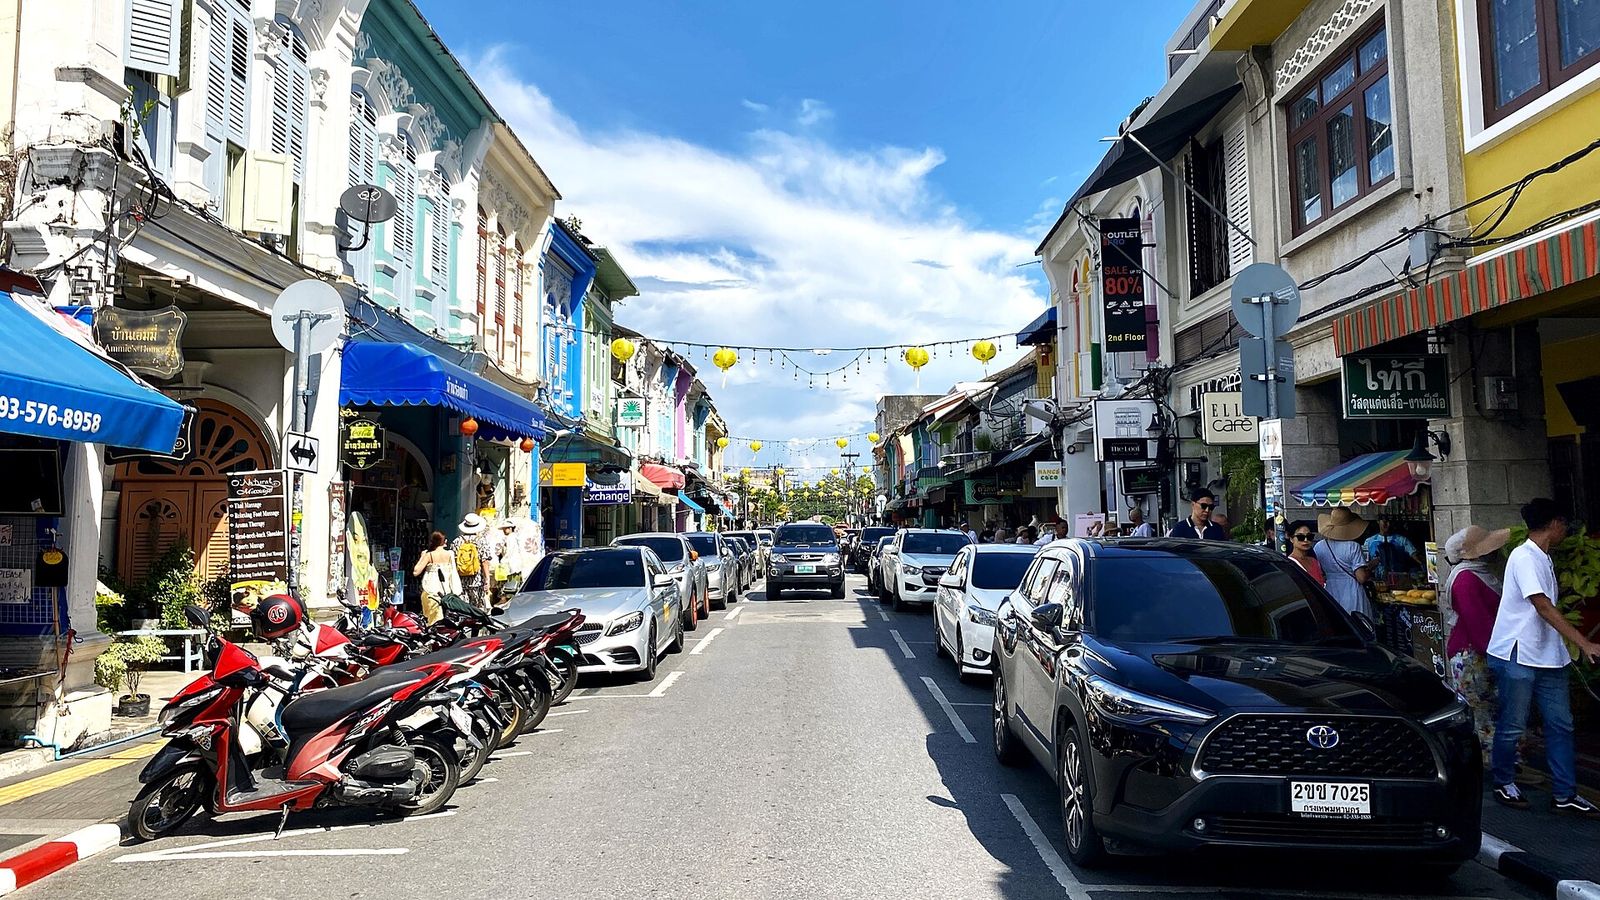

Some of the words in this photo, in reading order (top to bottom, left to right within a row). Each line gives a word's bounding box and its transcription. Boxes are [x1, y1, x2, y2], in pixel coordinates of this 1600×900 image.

[1107, 231, 1139, 239] OUTLET
[1104, 266, 1128, 275] SALE
[1105, 276, 1143, 295] 80%
[1107, 334, 1123, 342] 2nd
[1124, 333, 1146, 341] Floor
[0, 396, 102, 434] 93-576-8958
[1211, 403, 1242, 417] ELL
[584, 492, 629, 503] xchange
[271, 607, 285, 620] 46
[1413, 615, 1424, 624] tea
[1330, 785, 1369, 801] 7025
[1303, 804, 1360, 814] กรงเทพมหานคร
